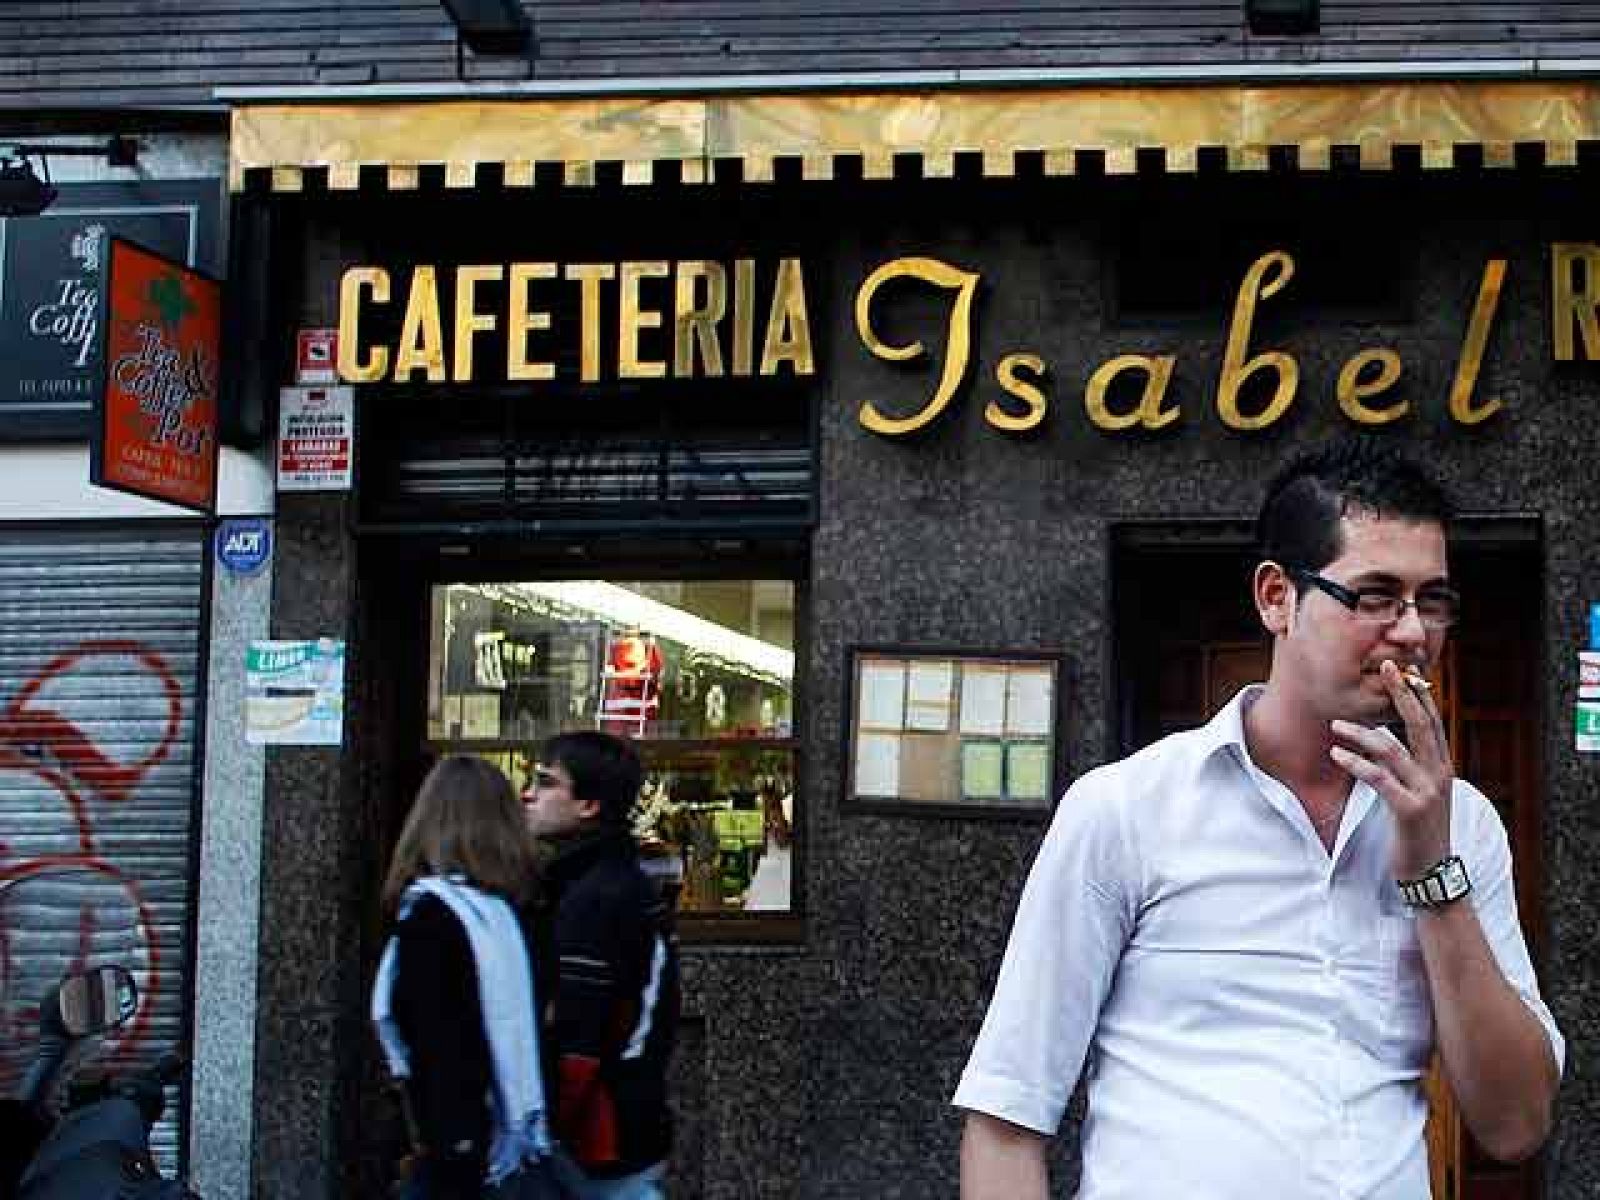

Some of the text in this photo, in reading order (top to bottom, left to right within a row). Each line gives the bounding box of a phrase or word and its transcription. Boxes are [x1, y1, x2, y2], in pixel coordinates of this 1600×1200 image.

[337, 258, 815, 384] CAFETERIA
[854, 250, 1508, 435] Isabel
[224, 532, 262, 553] ADT
